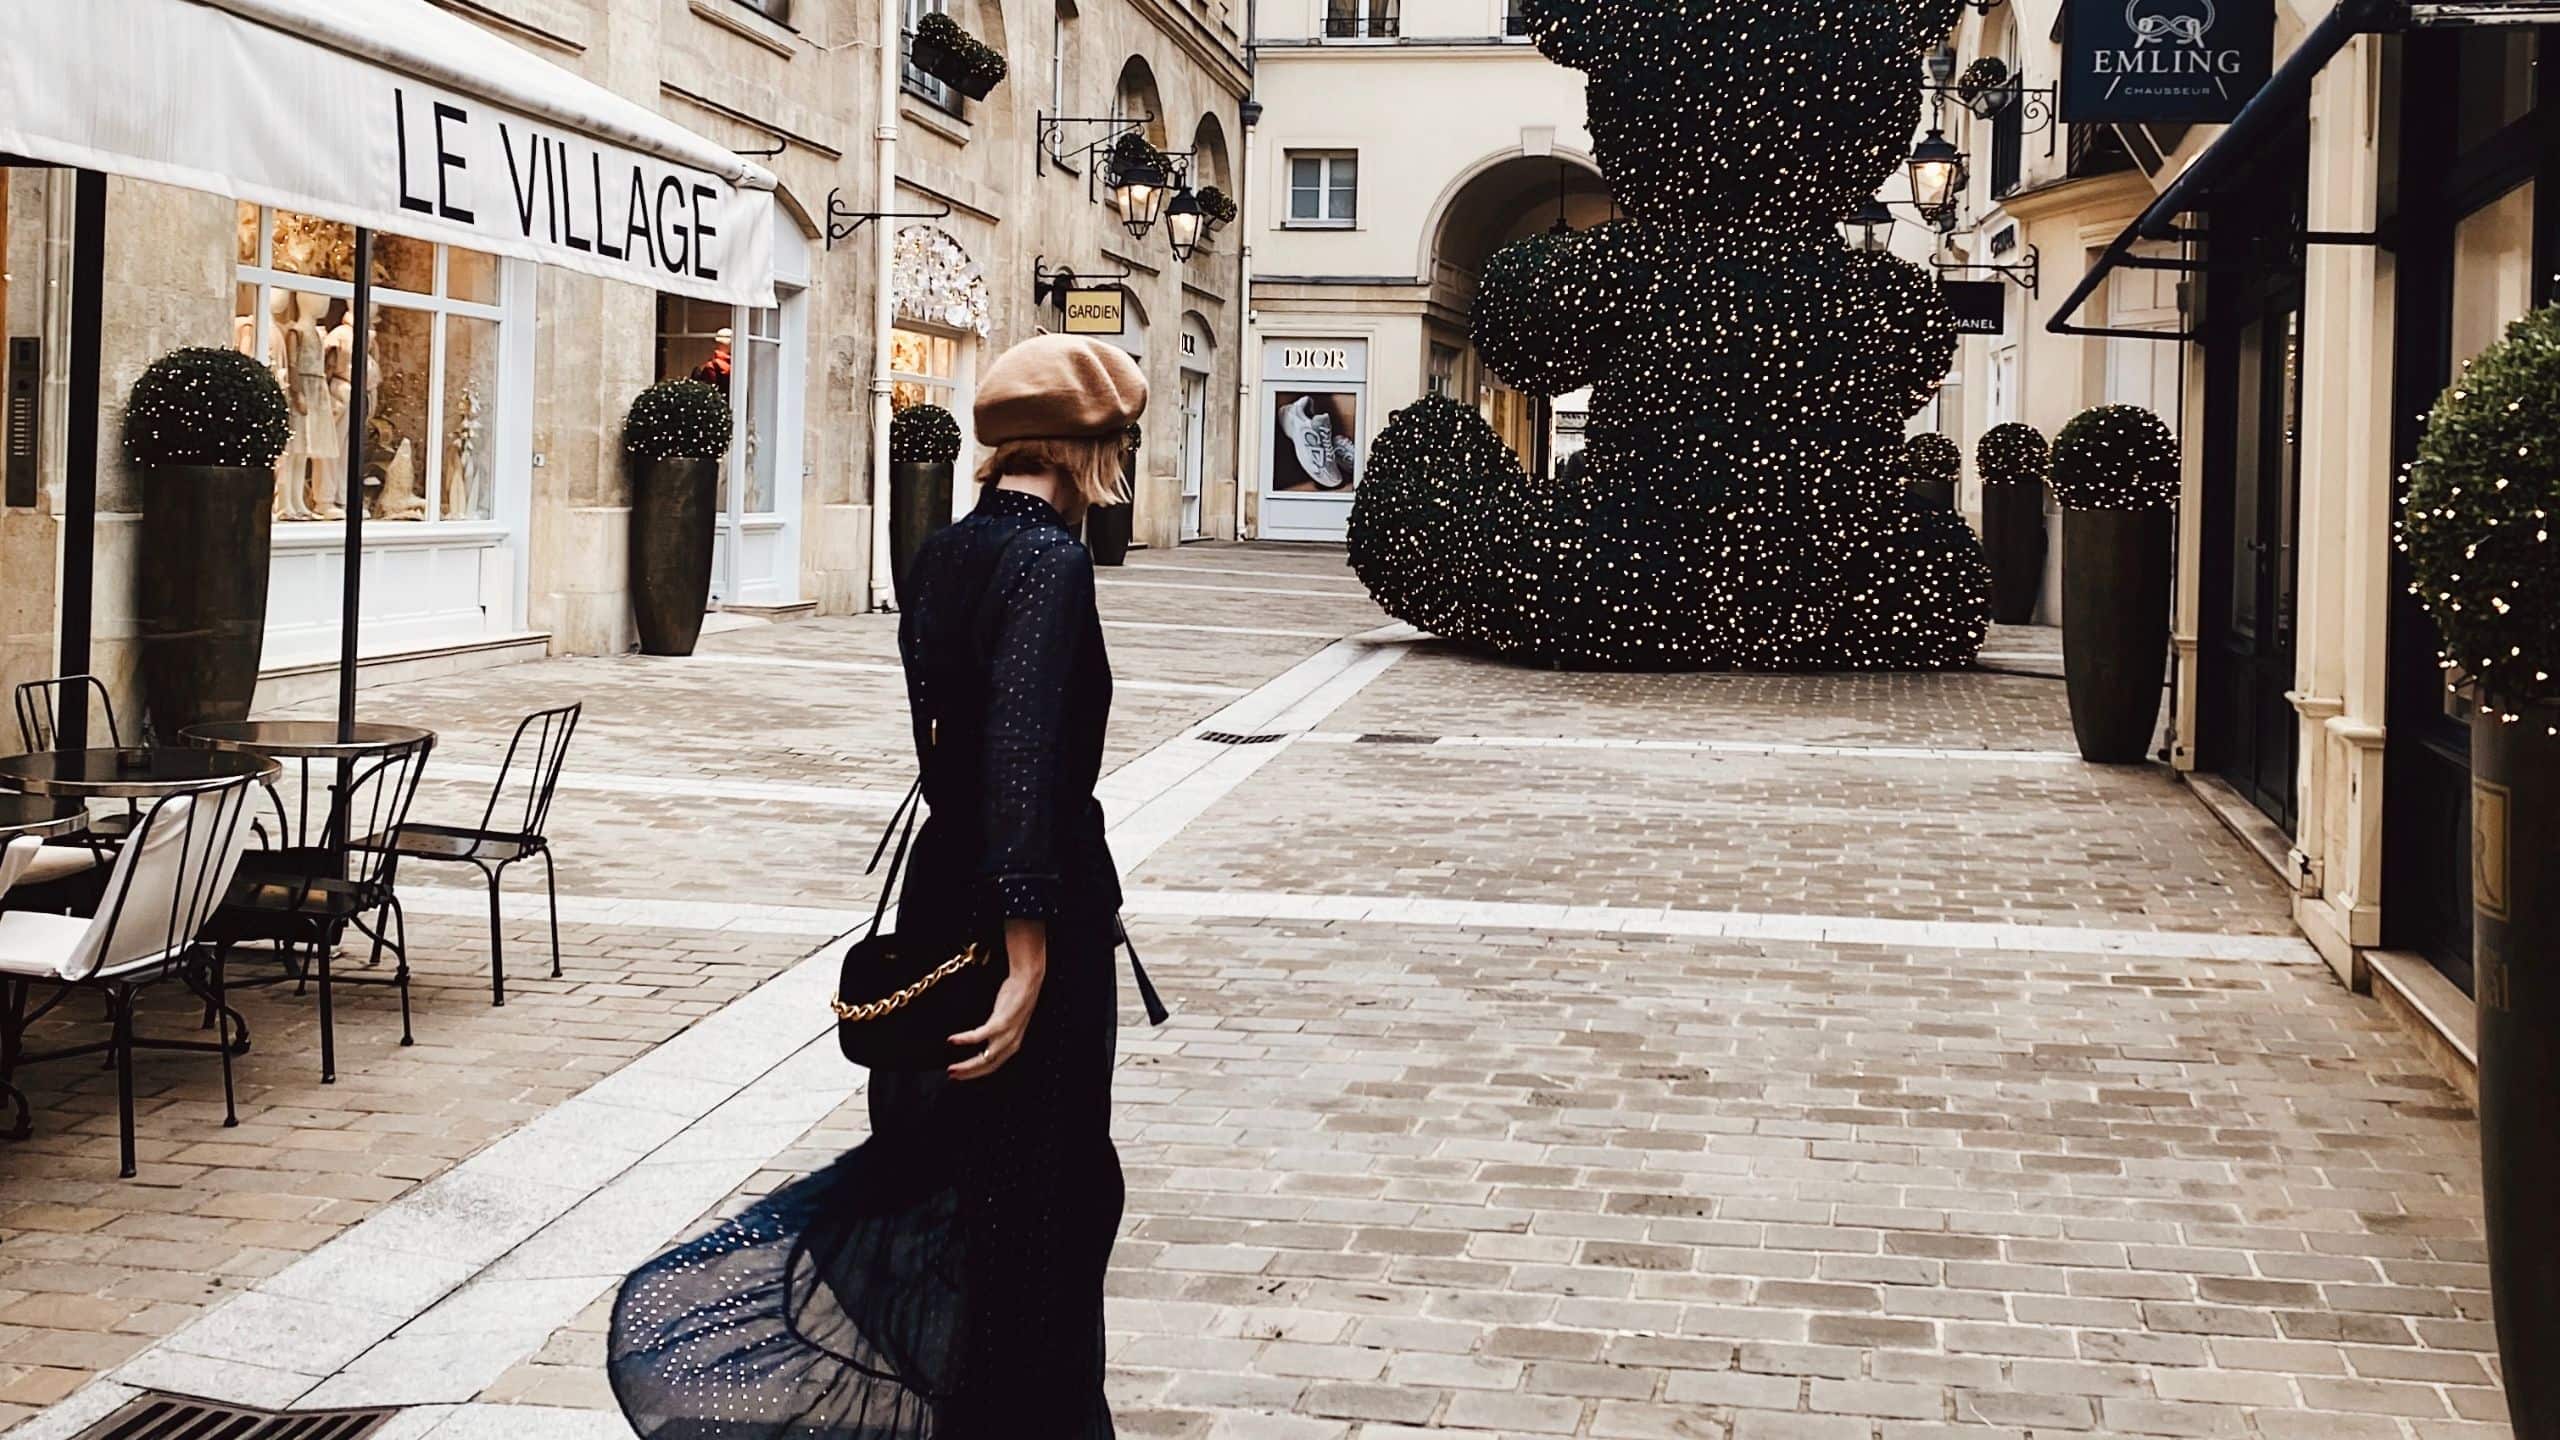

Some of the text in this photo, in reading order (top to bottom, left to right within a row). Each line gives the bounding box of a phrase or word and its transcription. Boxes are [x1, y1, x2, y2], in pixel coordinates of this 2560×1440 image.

[2092, 50, 2241, 74] EMLING
[2124, 87, 2210, 96] CHAUSSEUR
[394, 88, 719, 281] LE VILLAGE
[1068, 304, 1120, 319] GARDIEN
[1954, 318, 1996, 329] HANEL
[1284, 348, 1348, 369] DIOR
